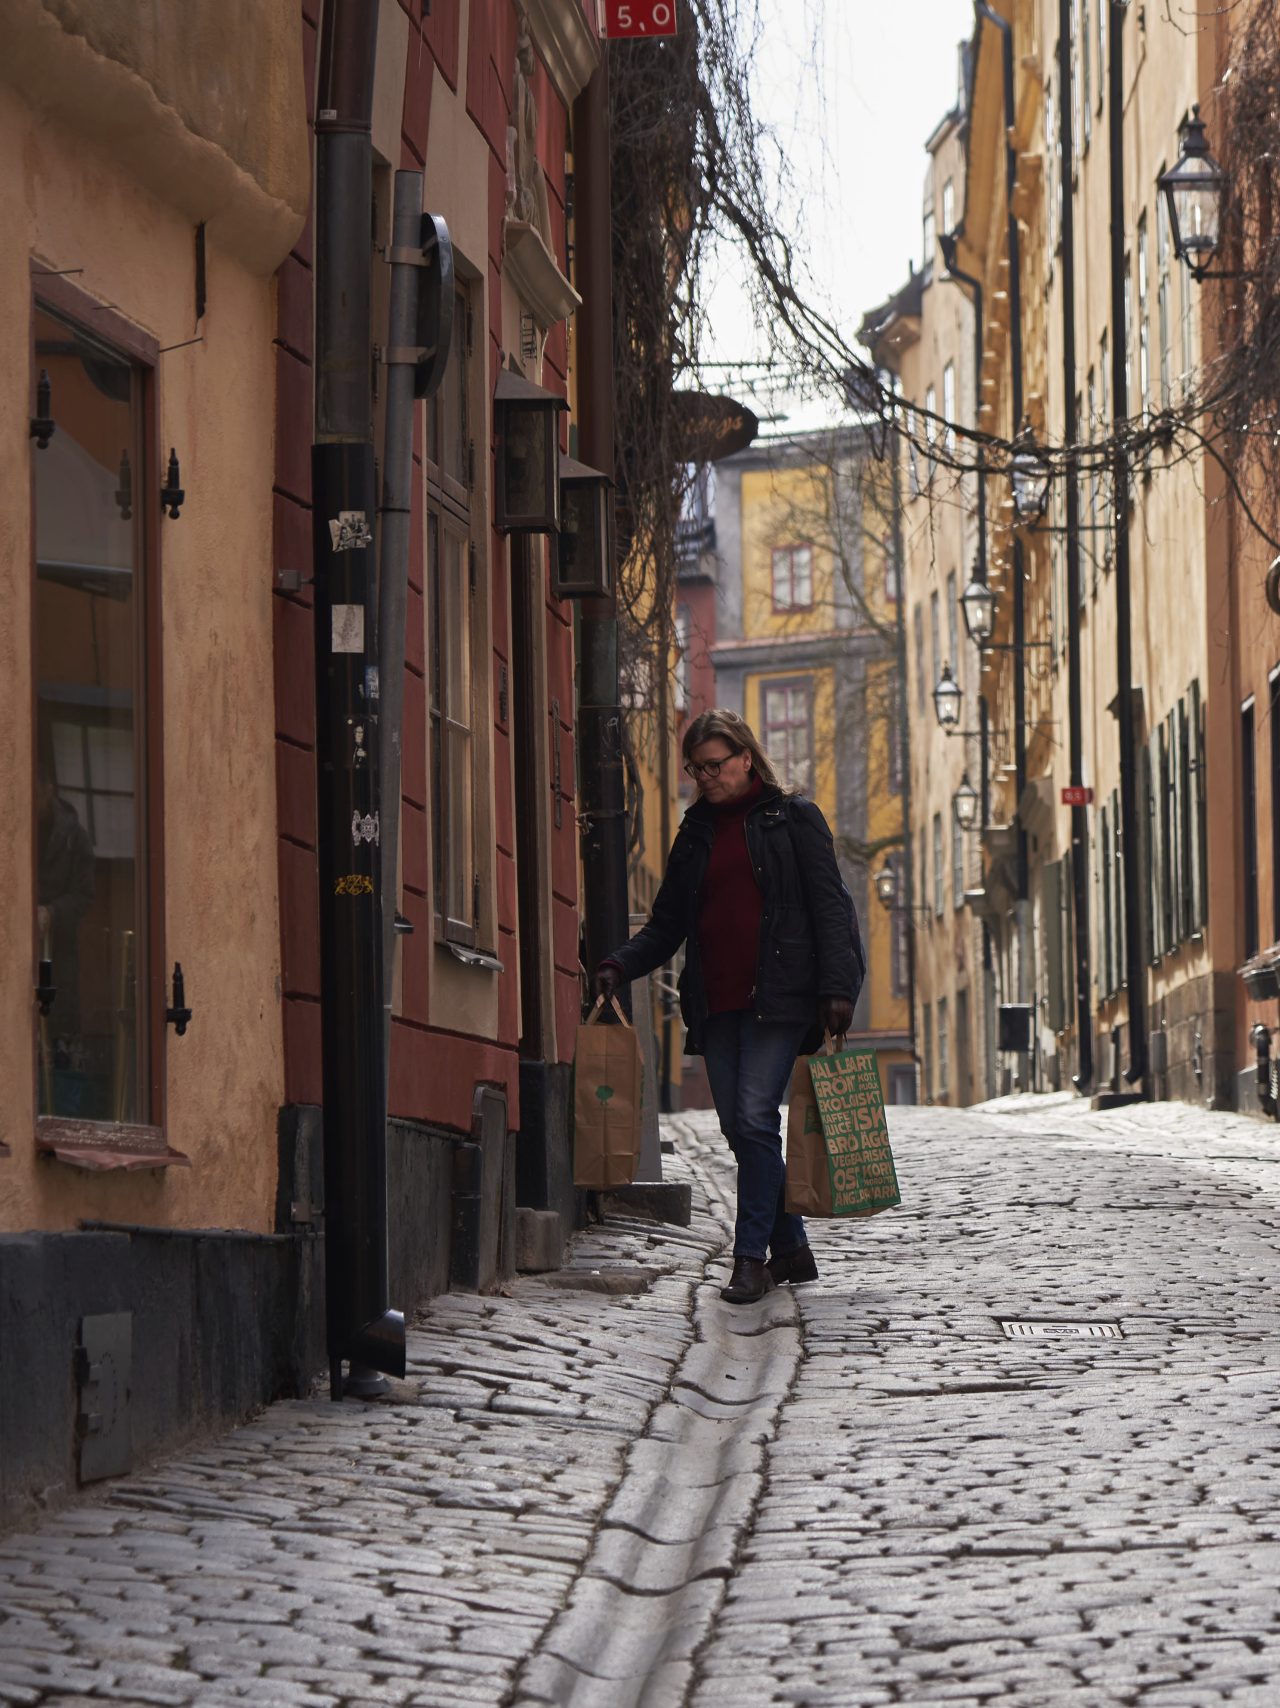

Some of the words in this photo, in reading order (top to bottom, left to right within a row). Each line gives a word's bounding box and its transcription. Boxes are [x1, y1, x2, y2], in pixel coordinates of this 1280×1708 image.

[617, 3, 670, 32] 5,0
[850, 1105, 886, 1131] ISK
[827, 1134, 859, 1154] BRÖ
[832, 1147, 890, 1168] VEGEARISK
